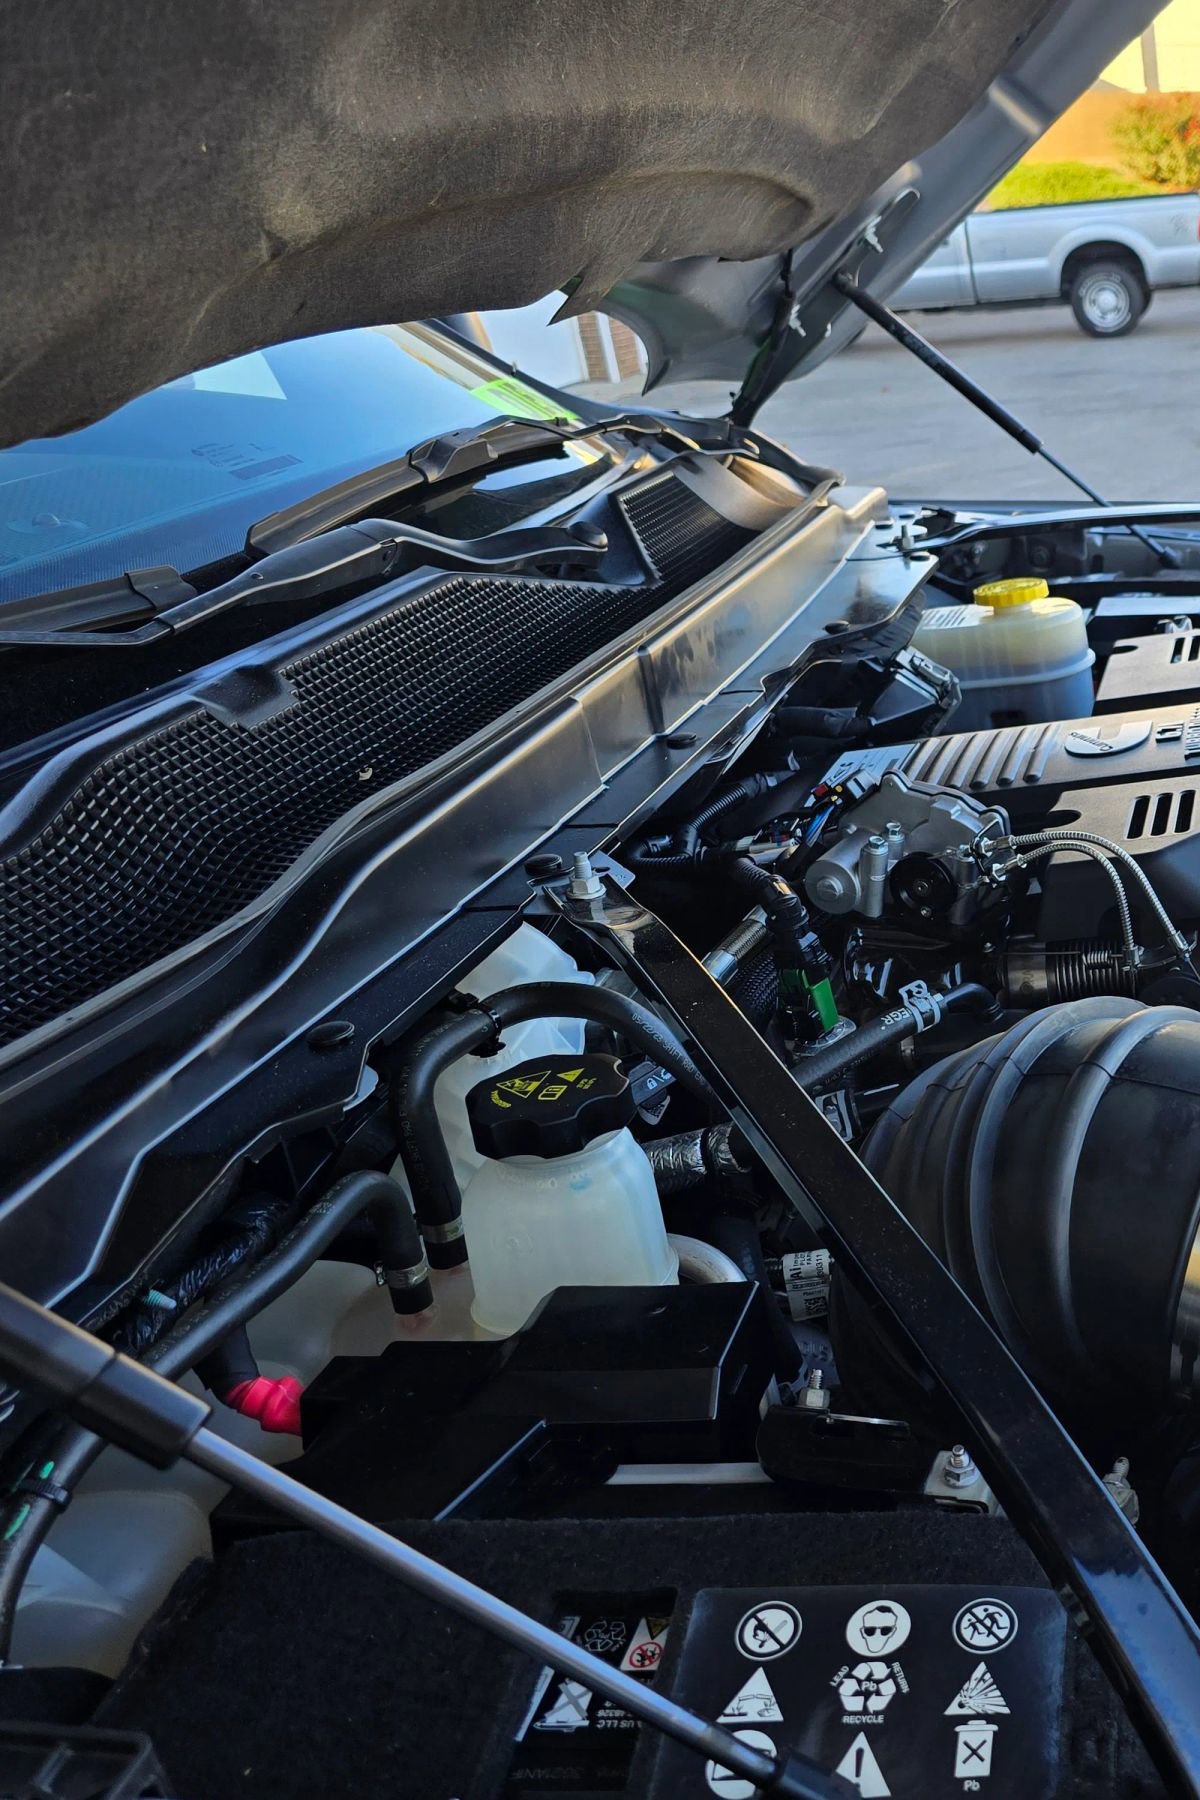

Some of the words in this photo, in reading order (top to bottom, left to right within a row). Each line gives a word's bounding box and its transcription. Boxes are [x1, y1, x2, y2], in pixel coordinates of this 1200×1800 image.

[1070, 731, 1114, 752] Cummins
[880, 1007, 911, 1025] EGR
[661, 1039, 683, 1061] SHIFT
[829, 1665, 850, 1687] LEAD
[891, 1661, 910, 1694] RETURN
[861, 1681, 877, 1691] Pb
[596, 1719, 619, 1728] LLC
[619, 1719, 635, 1728] US
[842, 1715, 885, 1724] RECYCLE
[962, 1778, 981, 1792] Pb
